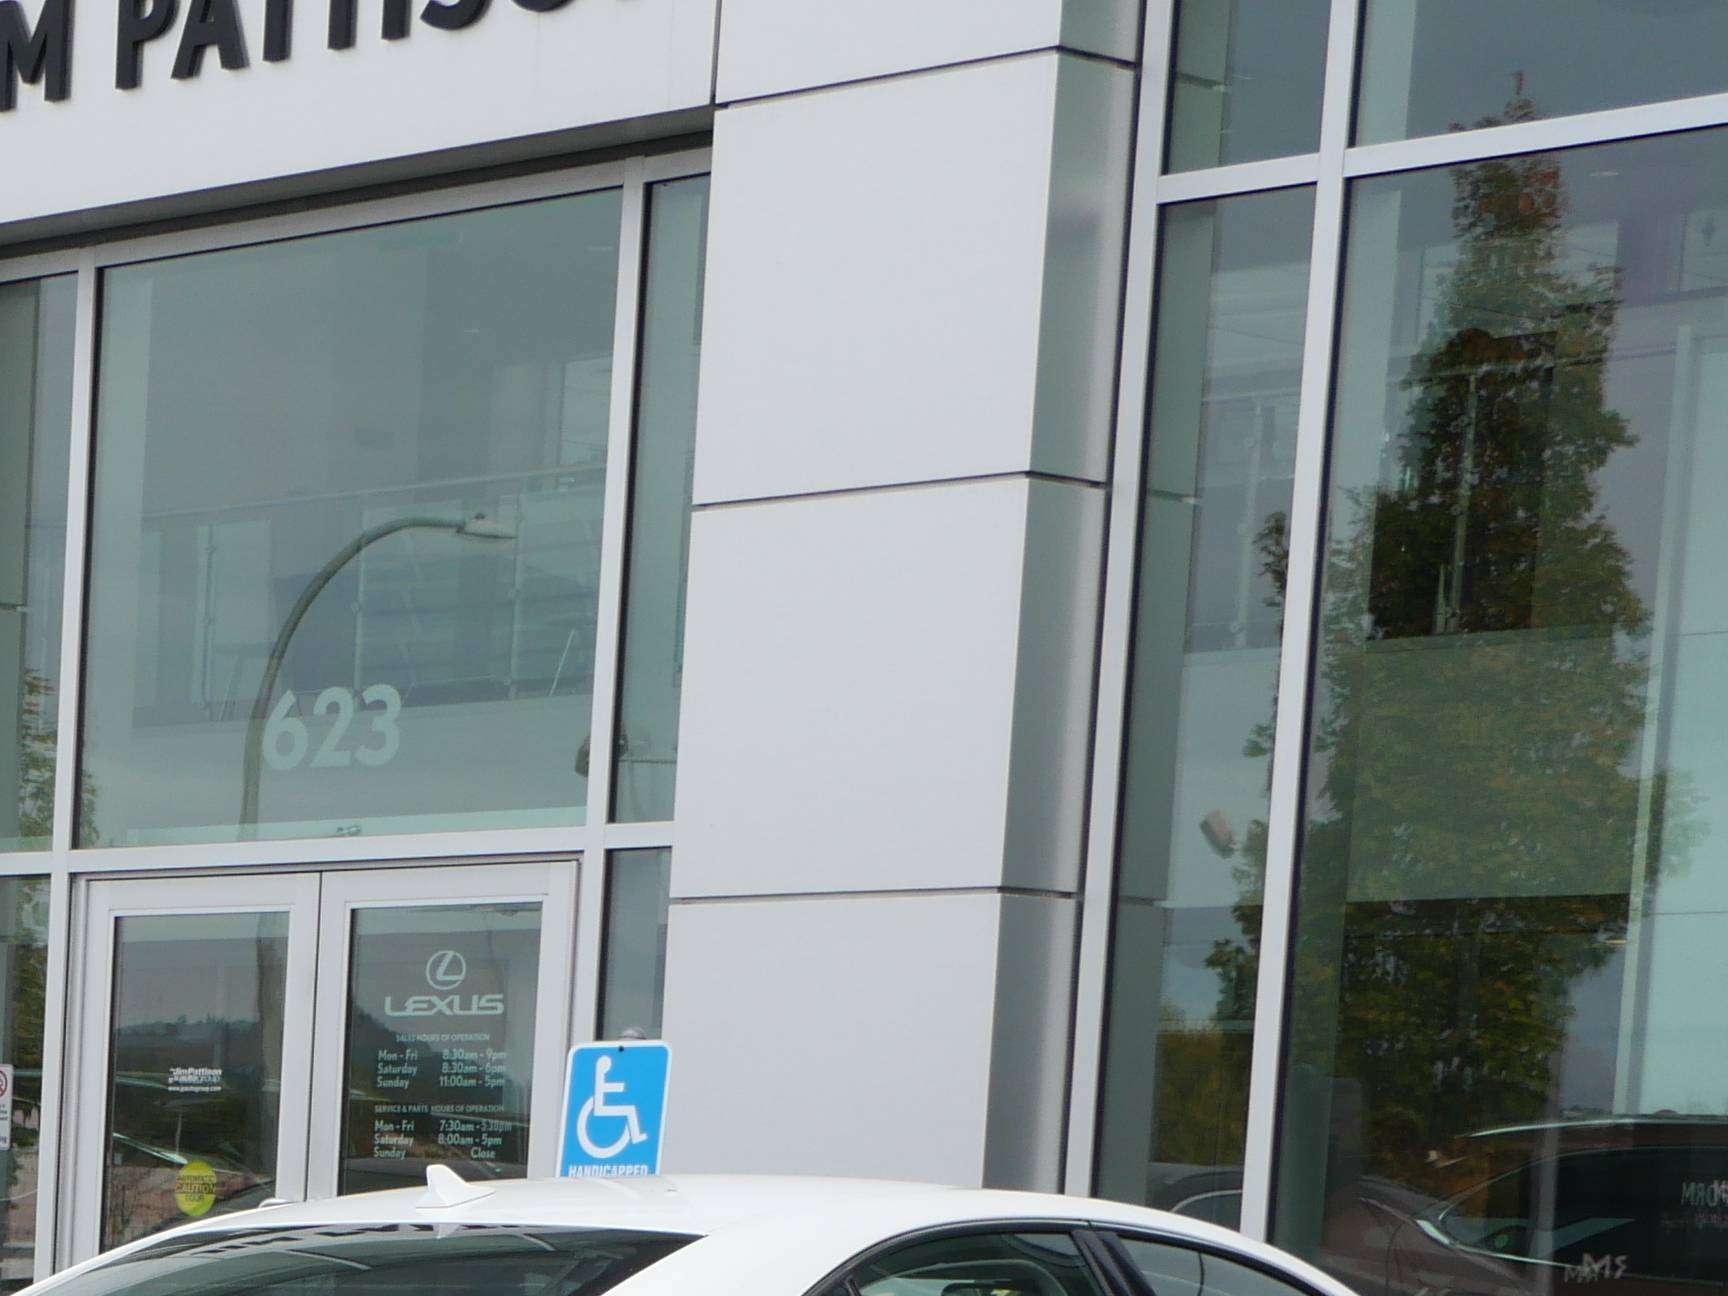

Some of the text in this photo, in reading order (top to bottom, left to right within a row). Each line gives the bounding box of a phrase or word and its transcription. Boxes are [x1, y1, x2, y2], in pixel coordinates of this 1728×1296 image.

[262, 684, 401, 770] 623
[384, 994, 504, 1016] LEXUS
[417, 1033, 439, 1042] HOURS
[451, 1032, 490, 1041] OPERATION
[378, 1050, 397, 1060] Mon
[406, 1049, 418, 1060] Fri
[442, 1049, 478, 1060] 8:30am
[377, 1063, 417, 1076] Saturday
[442, 1063, 477, 1073] 8:30am
[485, 1062, 506, 1075] 6pm
[377, 1076, 409, 1089] Sunday
[439, 1076, 476, 1087] 11:00am
[485, 1076, 504, 1088] 5pm
[374, 1105, 400, 1113] SERVICE
[408, 1105, 428, 1113] PARTS
[430, 1105, 454, 1113] HOURS
[465, 1104, 505, 1112] OPERATION
[375, 1120, 393, 1131] Mon
[402, 1120, 415, 1131] Fri
[439, 1120, 474, 1131] 7:30am
[374, 1133, 414, 1147] Saturday
[438, 1133, 473, 1145] 8:00am
[481, 1134, 502, 1146] 5pm
[374, 1147, 495, 1160] Sunday Close
[568, 1164, 648, 1177] HANDICAPPED
